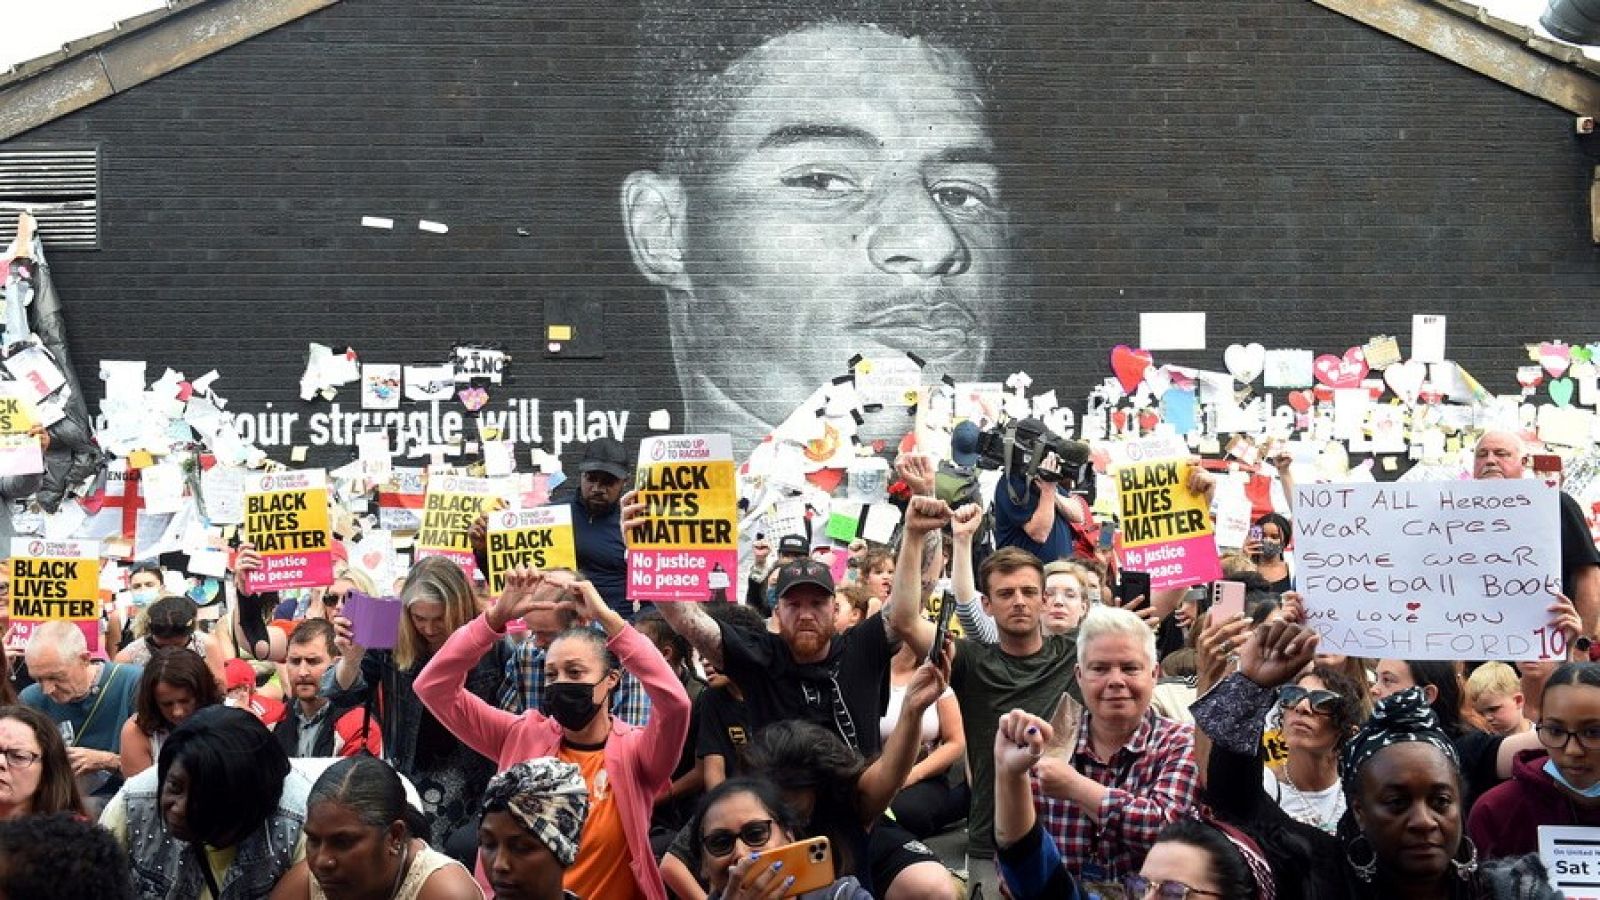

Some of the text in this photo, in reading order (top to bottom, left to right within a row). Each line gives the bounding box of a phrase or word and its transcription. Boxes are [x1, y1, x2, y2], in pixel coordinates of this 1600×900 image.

[479, 399, 543, 441] will
[552, 399, 630, 455] play
[667, 439, 704, 449] STAND UP
[667, 449, 710, 459] TO RACISM
[1120, 462, 1179, 491] BLACK
[248, 493, 307, 514] BLACK
[428, 494, 483, 513] BLACK
[1122, 489, 1172, 517] LIVES
[1299, 488, 1354, 510] NOT
[1372, 489, 1418, 510] ALL
[248, 512, 300, 533] LIVES
[424, 511, 472, 530] LIVES
[1124, 508, 1205, 543] MATTER
[248, 530, 326, 551] MATTER
[421, 529, 471, 549] MATT
[490, 529, 554, 552] BLACK
[631, 519, 732, 544] MATTER
[268, 556, 308, 570] justice
[492, 550, 547, 572] LIVES
[633, 552, 706, 571] No justice
[1126, 545, 1185, 568] No justice
[14, 560, 78, 579] BLACK
[249, 570, 303, 584] No peace
[633, 570, 653, 585] No
[655, 572, 699, 589] peace
[1149, 562, 1182, 578] peace
[14, 579, 68, 598] LIVES
[14, 599, 95, 617] MATTER
[1534, 625, 1566, 659] 10
[1556, 860, 1590, 876] Sat
